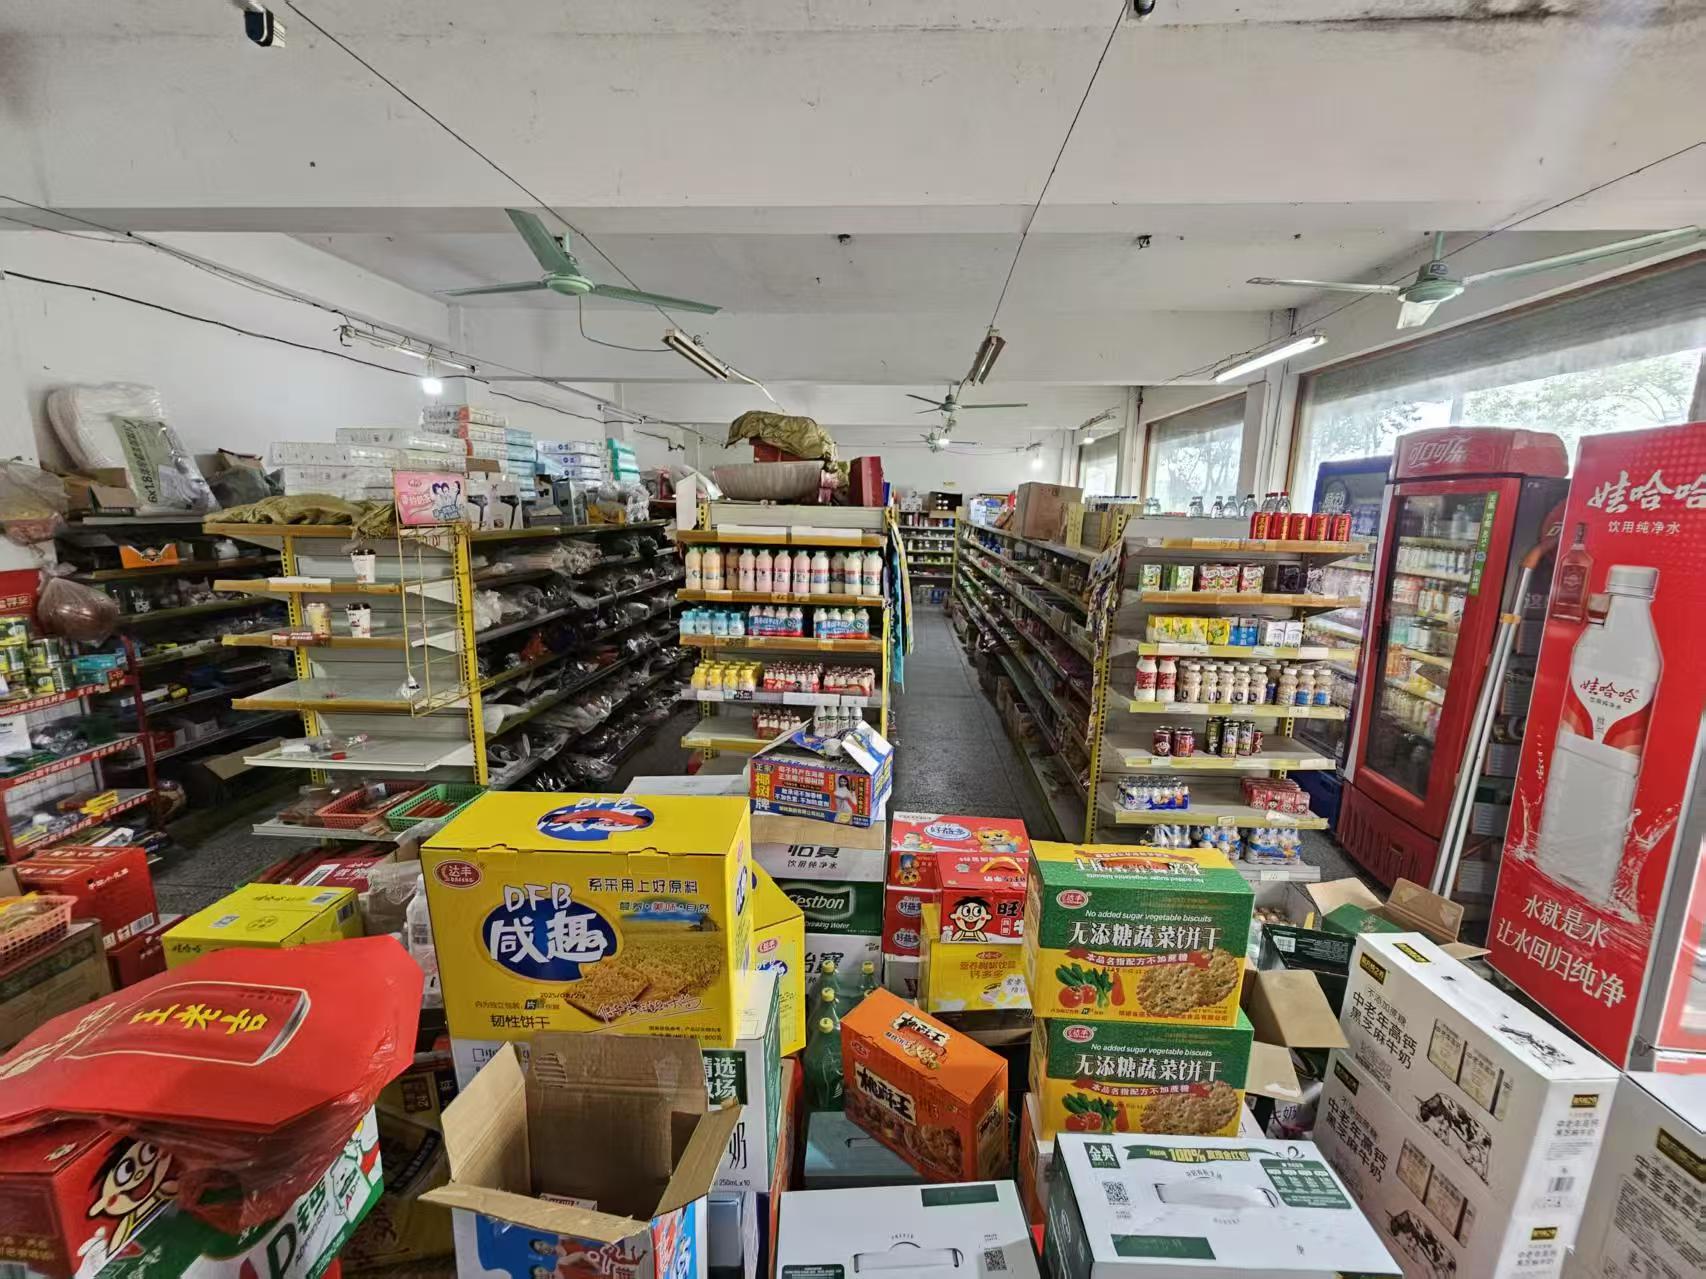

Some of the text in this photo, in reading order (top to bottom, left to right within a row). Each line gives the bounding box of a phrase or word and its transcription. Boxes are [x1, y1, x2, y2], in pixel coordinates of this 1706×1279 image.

[1586, 470, 1706, 513] 娃哈哈
[1608, 521, 1681, 534] 饮用纯净水
[1580, 677, 1639, 704] 娃哈哈
[576, 797, 635, 808] DFB
[787, 859, 838, 869] 饮用纯净水
[503, 882, 572, 912] DFB
[589, 878, 698, 894] 系采用上好原料
[996, 900, 1025, 916] 旺
[1085, 909, 1212, 923] No added sugar vegetable biscuits
[1522, 895, 1610, 948] 水就是水
[490, 911, 608, 964] 咸趣
[1068, 921, 1221, 950] 无添糖蔬菜饼干
[1497, 918, 1626, 1008] 让水回归纯净
[128, 1003, 268, 1034] 王老吉
[490, 1015, 550, 1028] 韧性饼干
[1353, 991, 1417, 1056] 中老年高钙
[1091, 1043, 1101, 1051] No
[1127, 1046, 1147, 1054] sugar
[1149, 1047, 1184, 1056] vegetable
[1185, 1048, 1212, 1057] biscuits
[1350, 1006, 1412, 1069] 黑芝麻牛奶
[1075, 1054, 1222, 1082] 无添糖蔬菜饼干
[1326, 1111, 1381, 1183] 黑芝麻牛奶
[1329, 1097, 1388, 1170] 中老年高钙
[1089, 1145, 1115, 1162] 金典
